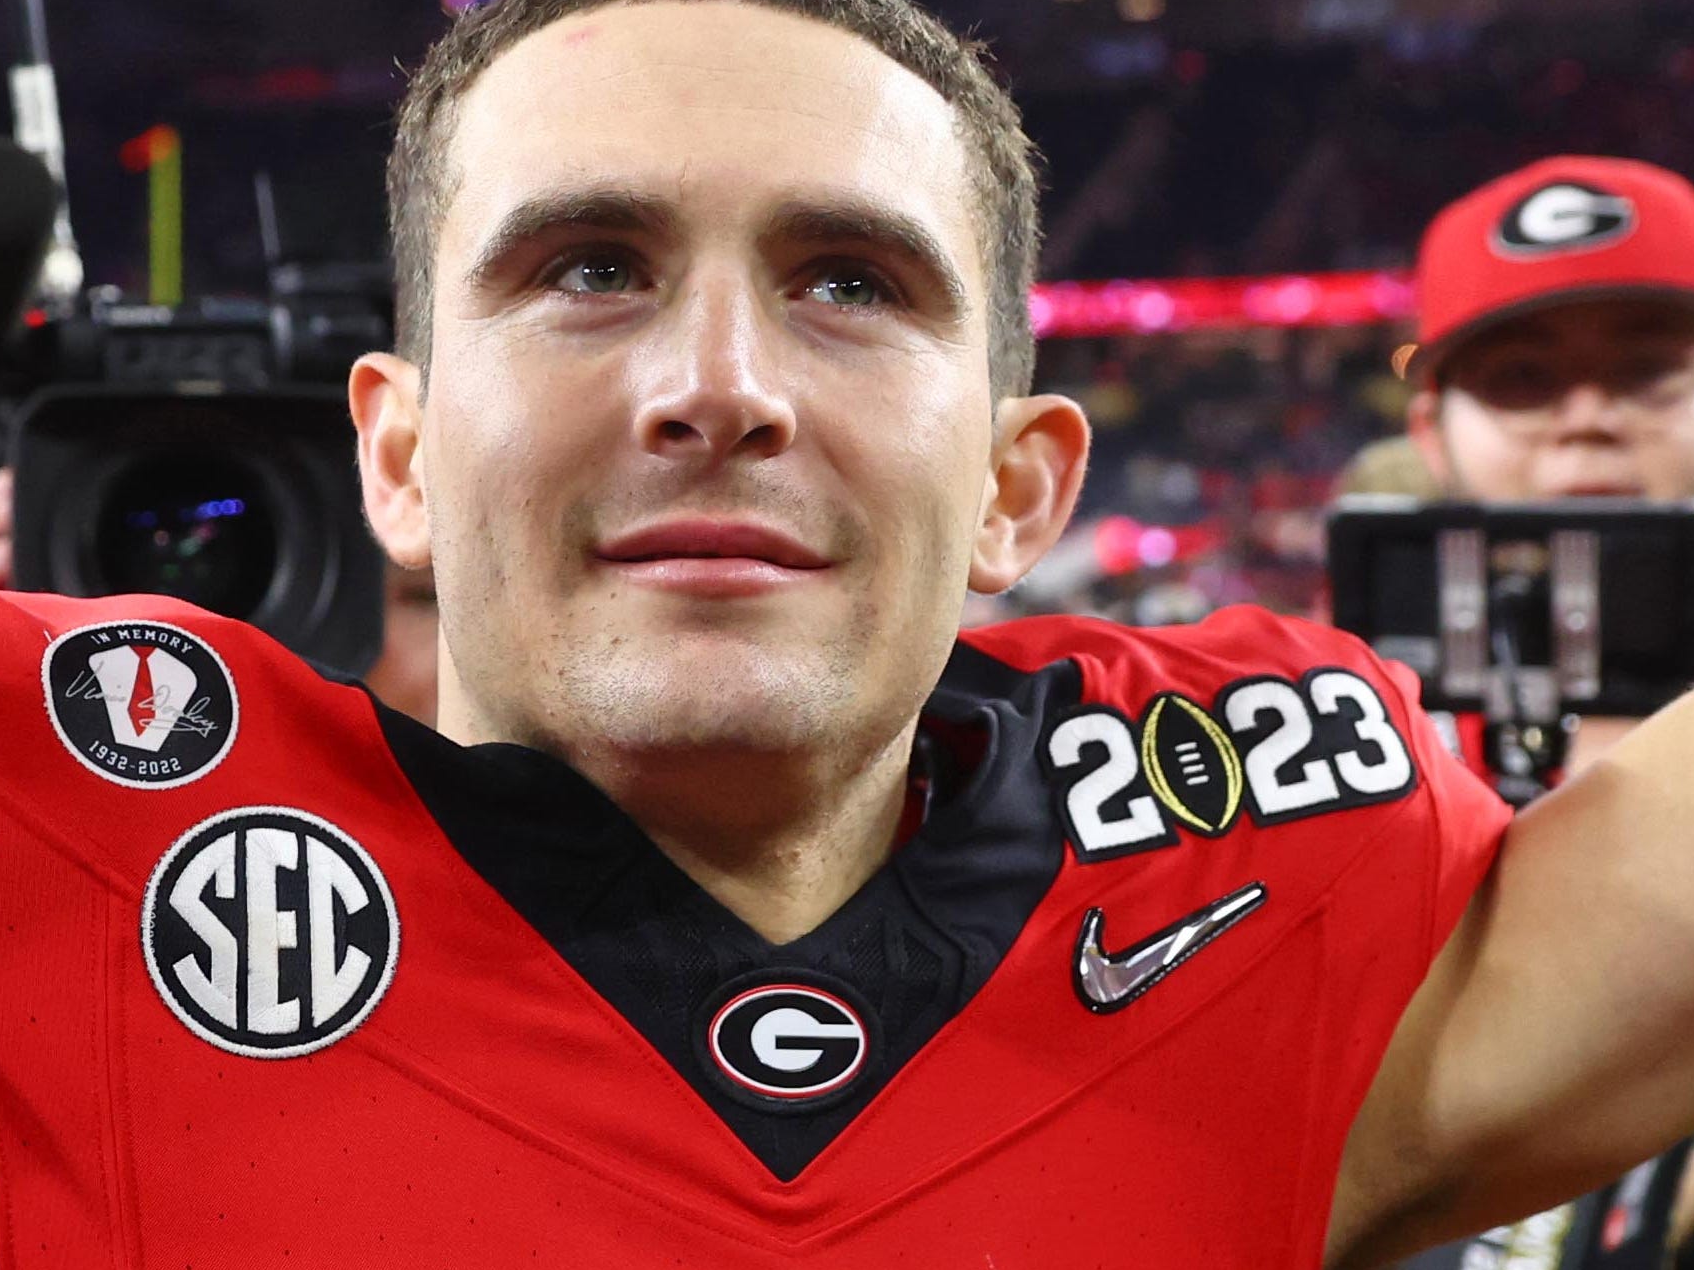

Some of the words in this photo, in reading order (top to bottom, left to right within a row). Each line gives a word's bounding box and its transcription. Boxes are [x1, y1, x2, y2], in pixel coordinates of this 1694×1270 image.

[91, 634, 111, 645] IN
[117, 628, 194, 654] MEMORY
[88, 740, 183, 776] 1932-2022
[168, 827, 373, 1036] SEC
